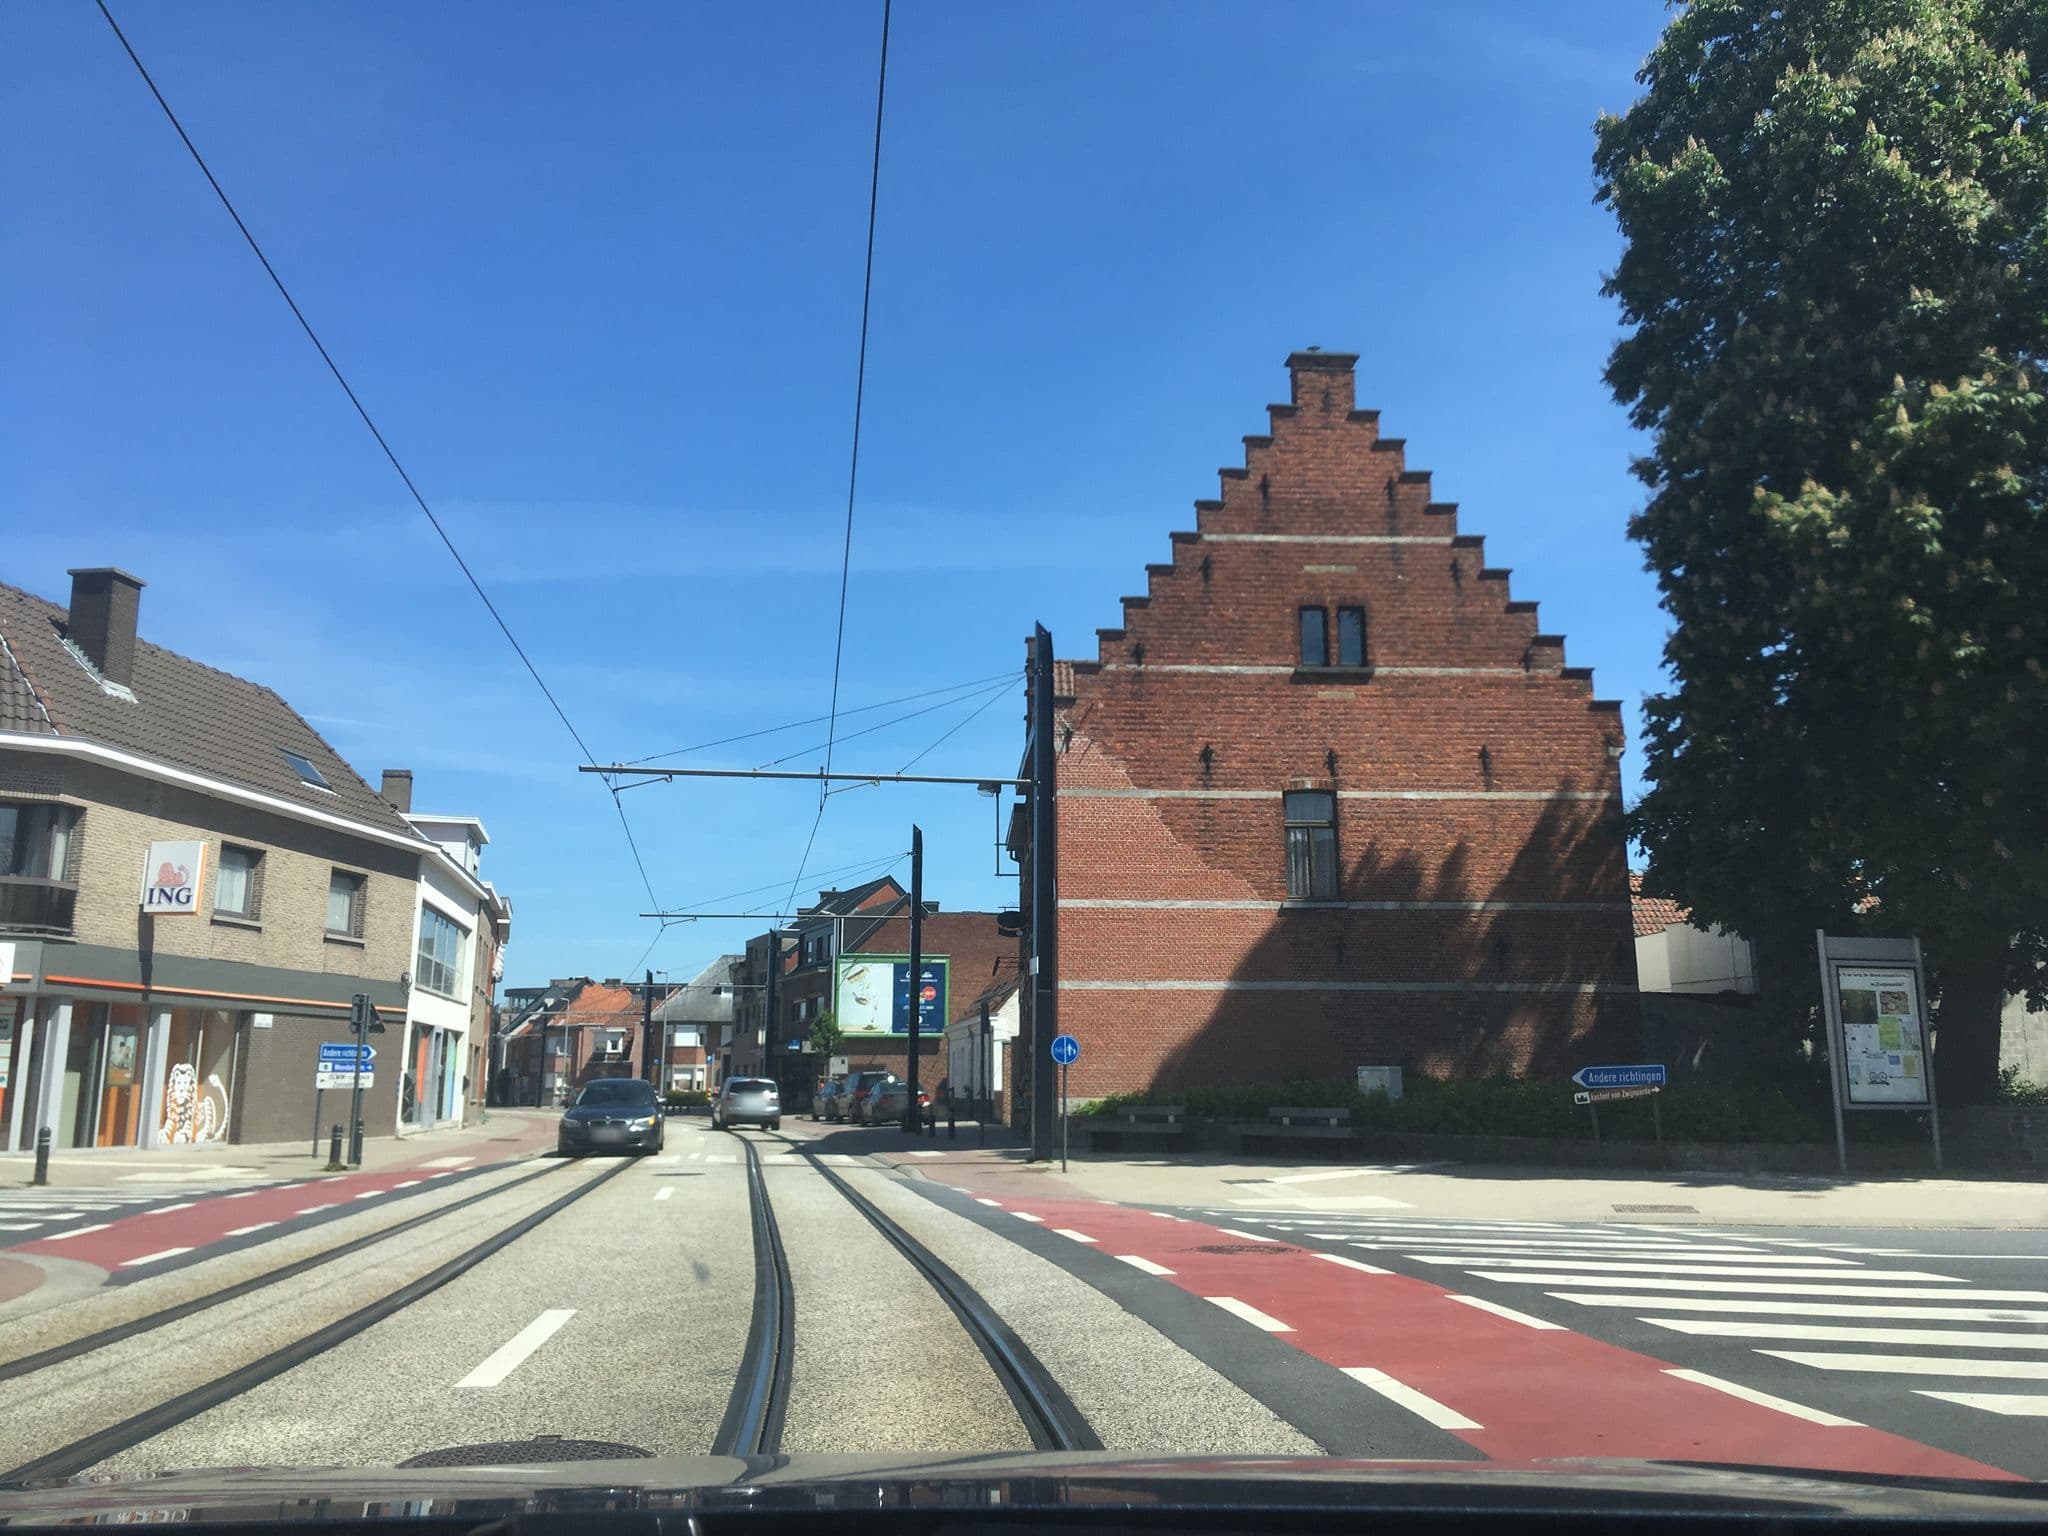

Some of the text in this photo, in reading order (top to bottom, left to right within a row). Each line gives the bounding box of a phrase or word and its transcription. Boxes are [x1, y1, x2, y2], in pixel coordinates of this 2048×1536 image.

[148, 887, 192, 905] ING
[1588, 1071, 1662, 1084] Andere richtingen
